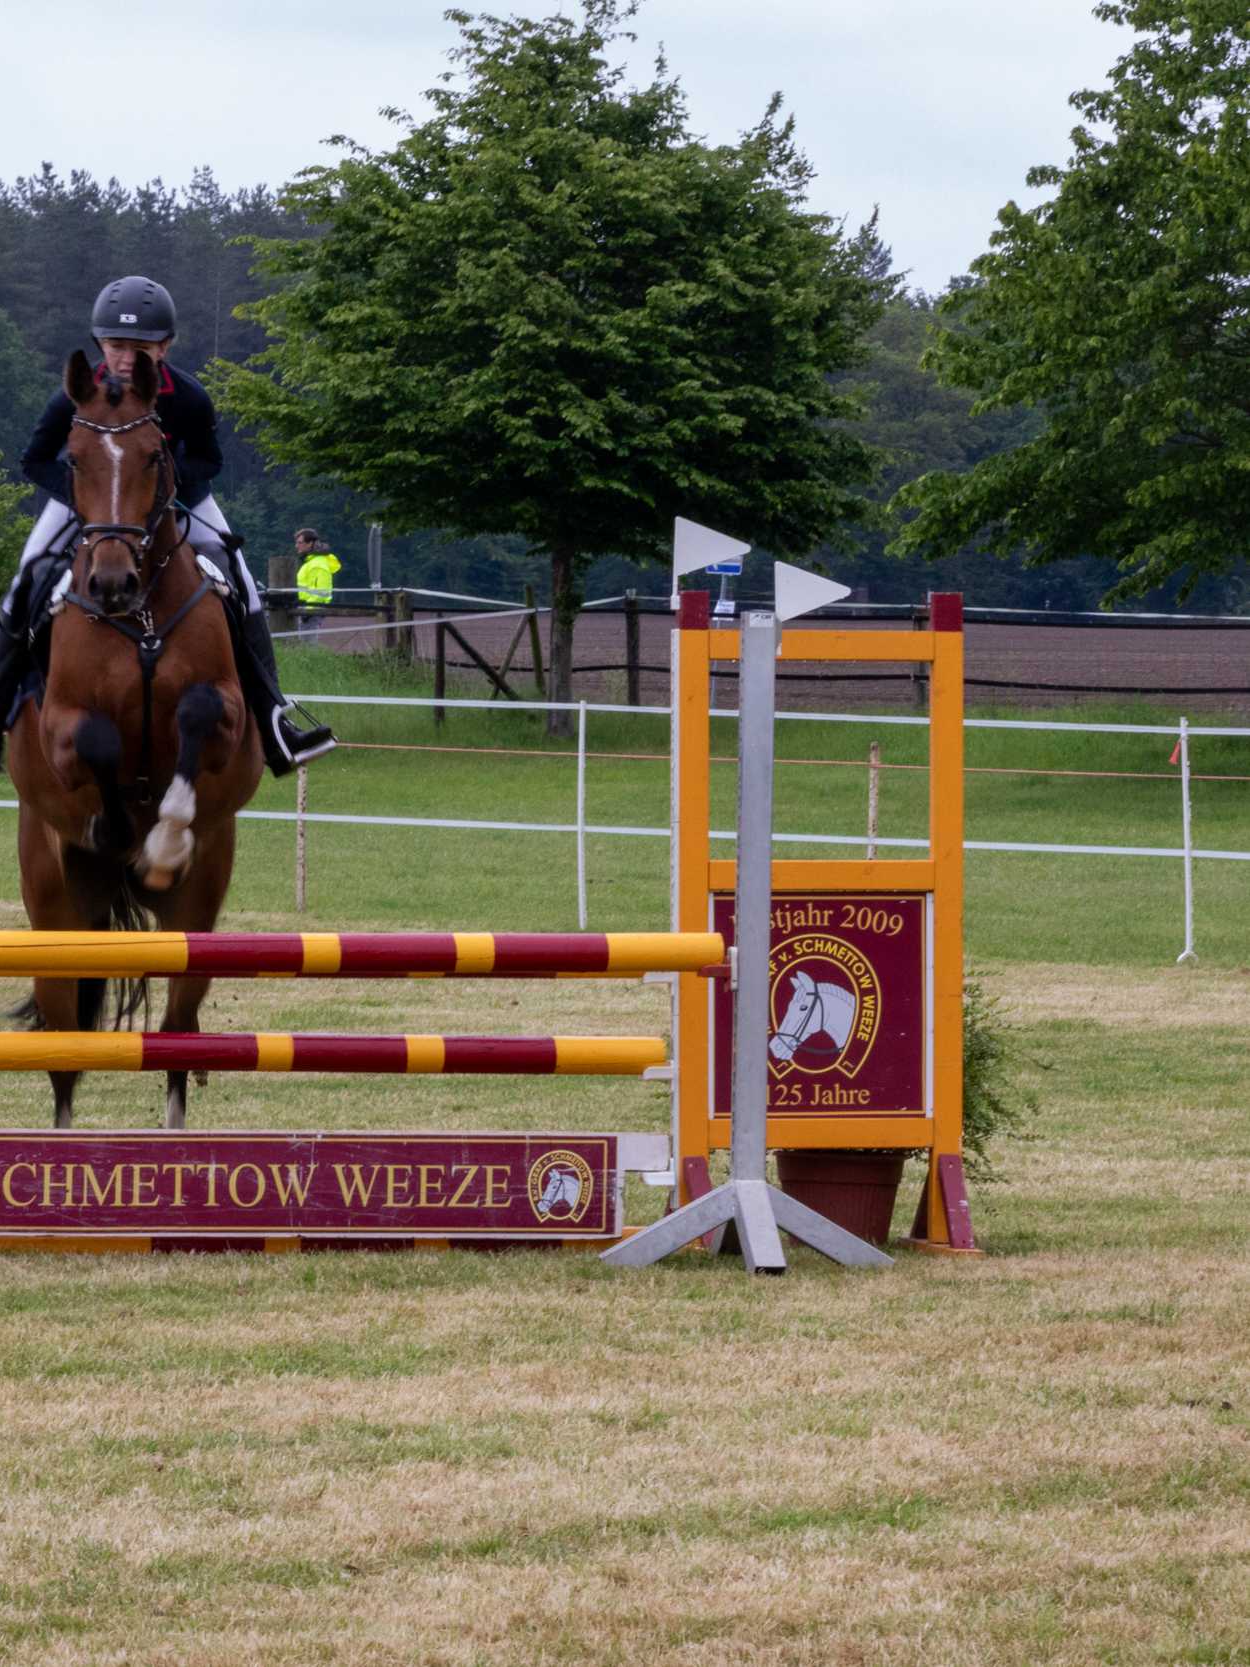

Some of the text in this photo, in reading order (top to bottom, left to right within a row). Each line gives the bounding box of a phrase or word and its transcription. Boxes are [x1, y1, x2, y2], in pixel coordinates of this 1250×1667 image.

[840, 904, 905, 937] 2009
[793, 938, 874, 989] SCHMETTOW
[857, 994, 875, 1042] WEEZE
[810, 1083, 871, 1106] Jahre
[331, 1162, 513, 1209] WEEZE
